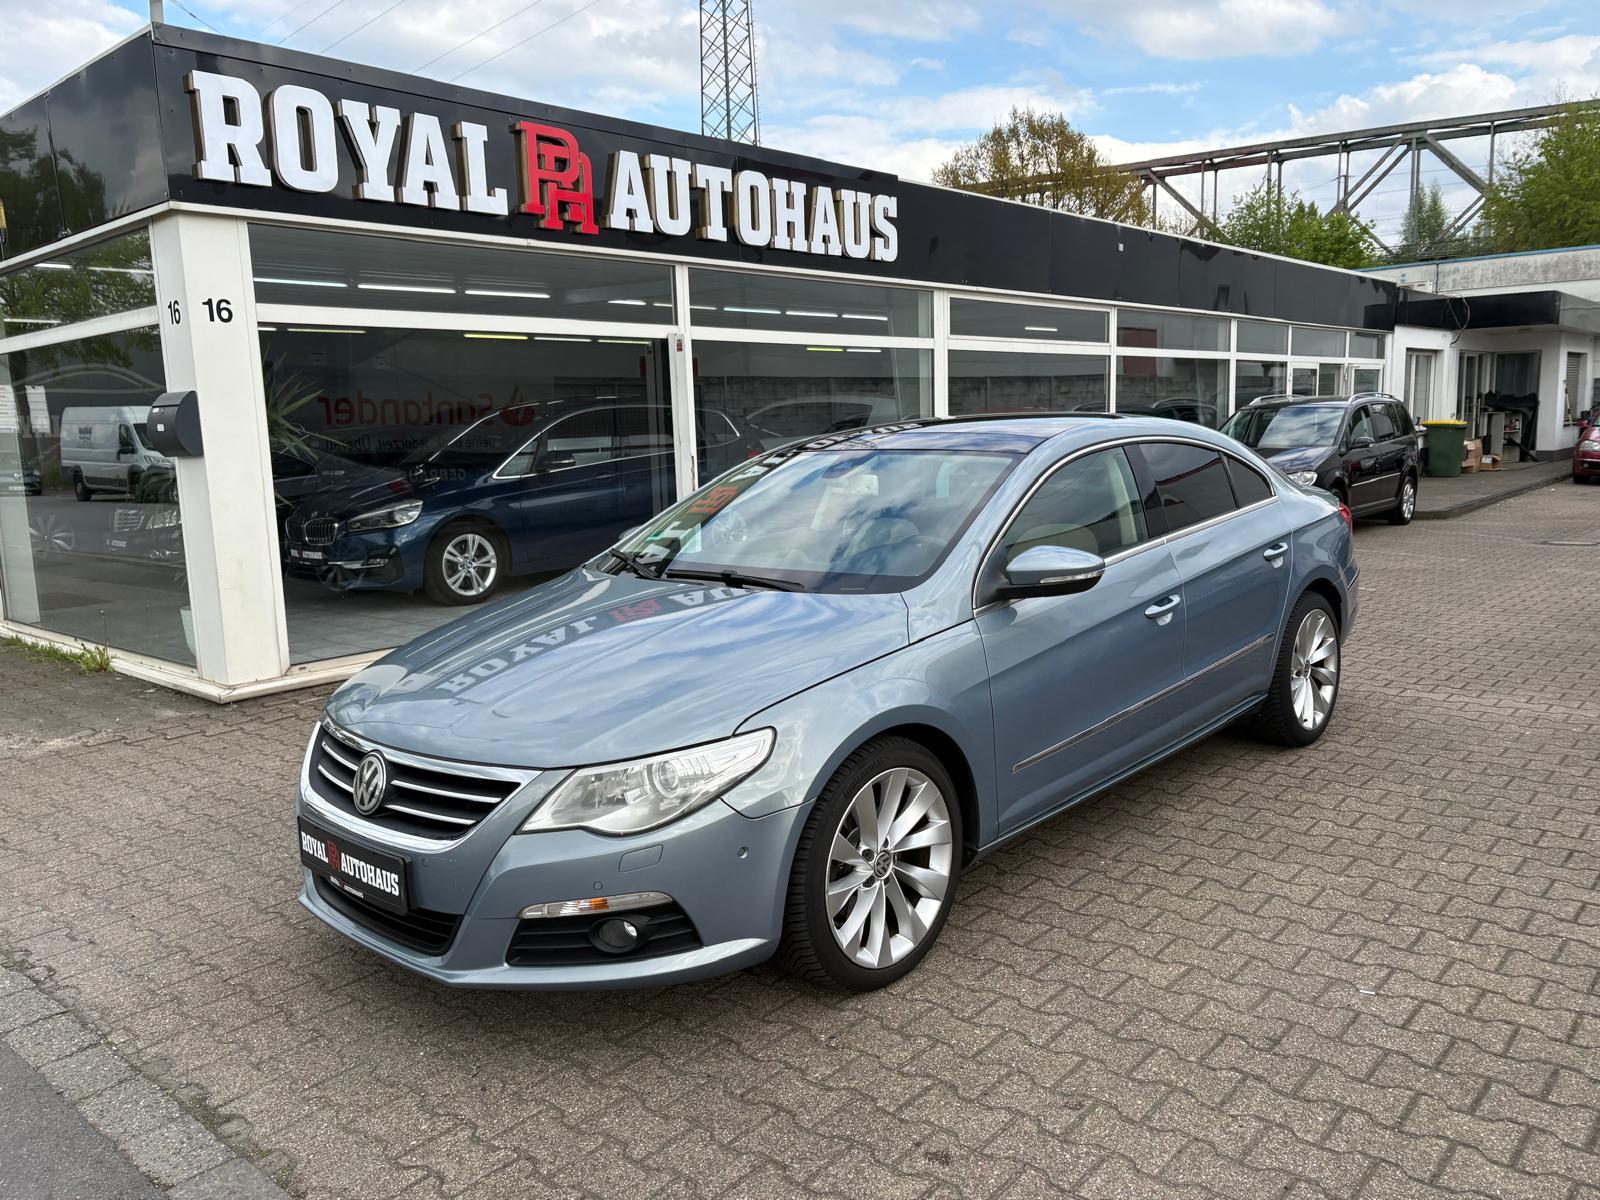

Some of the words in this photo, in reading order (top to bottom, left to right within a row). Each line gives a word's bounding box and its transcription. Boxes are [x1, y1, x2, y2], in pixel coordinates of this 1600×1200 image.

[184, 70, 508, 215] ROYAL
[604, 150, 898, 263] AUTOHAUS
[168, 300, 181, 325] 16
[202, 298, 233, 323] 16
[301, 831, 329, 863] ROYAL
[341, 853, 399, 896] AUTOHAUS
